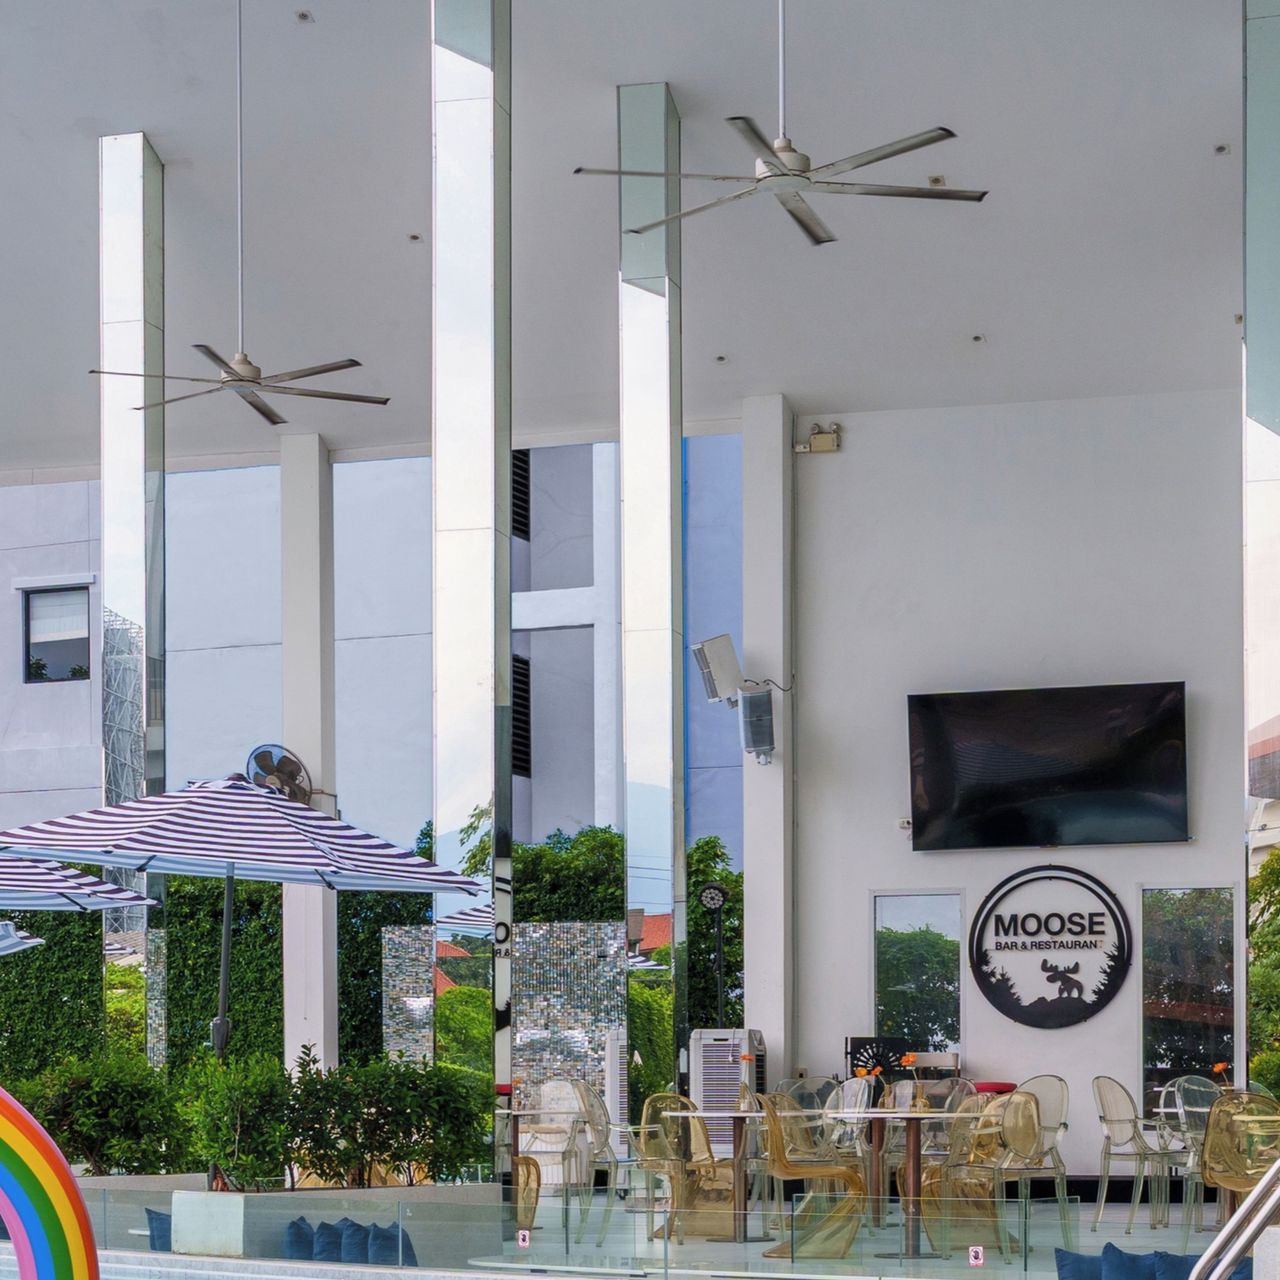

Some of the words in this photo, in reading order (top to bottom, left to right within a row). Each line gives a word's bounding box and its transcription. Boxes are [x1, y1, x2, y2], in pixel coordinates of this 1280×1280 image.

[994, 912, 1106, 937] MOOSE
[995, 941, 1018, 951] BAR
[1020, 941, 1028, 950] &
